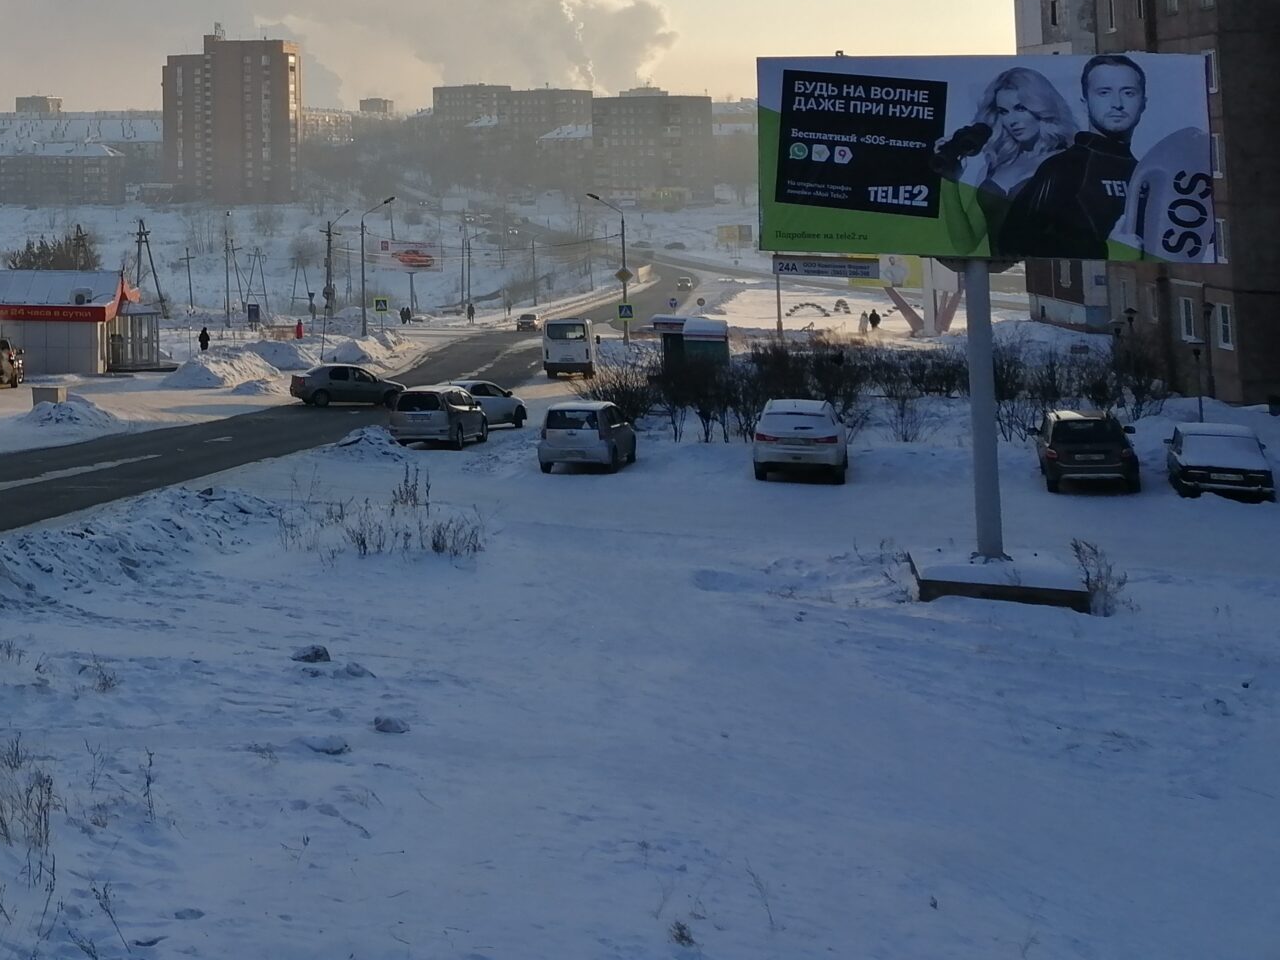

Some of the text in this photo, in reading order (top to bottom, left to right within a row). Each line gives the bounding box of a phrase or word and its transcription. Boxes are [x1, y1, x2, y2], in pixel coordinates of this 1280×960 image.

[794, 80, 929, 103] БУДЬ НА ВОЛНЕ
[792, 96, 934, 120] ДАЖЕ ПРИ НУЛЕ
[791, 128, 927, 148] Бесплатный «SOS-пакет»
[868, 184, 929, 207] TELE2
[1162, 170, 1213, 258] SOS
[775, 230, 820, 241] Подробнее
[836, 231, 868, 241] tele2.ru
[62, 310, 92, 319] сутки
